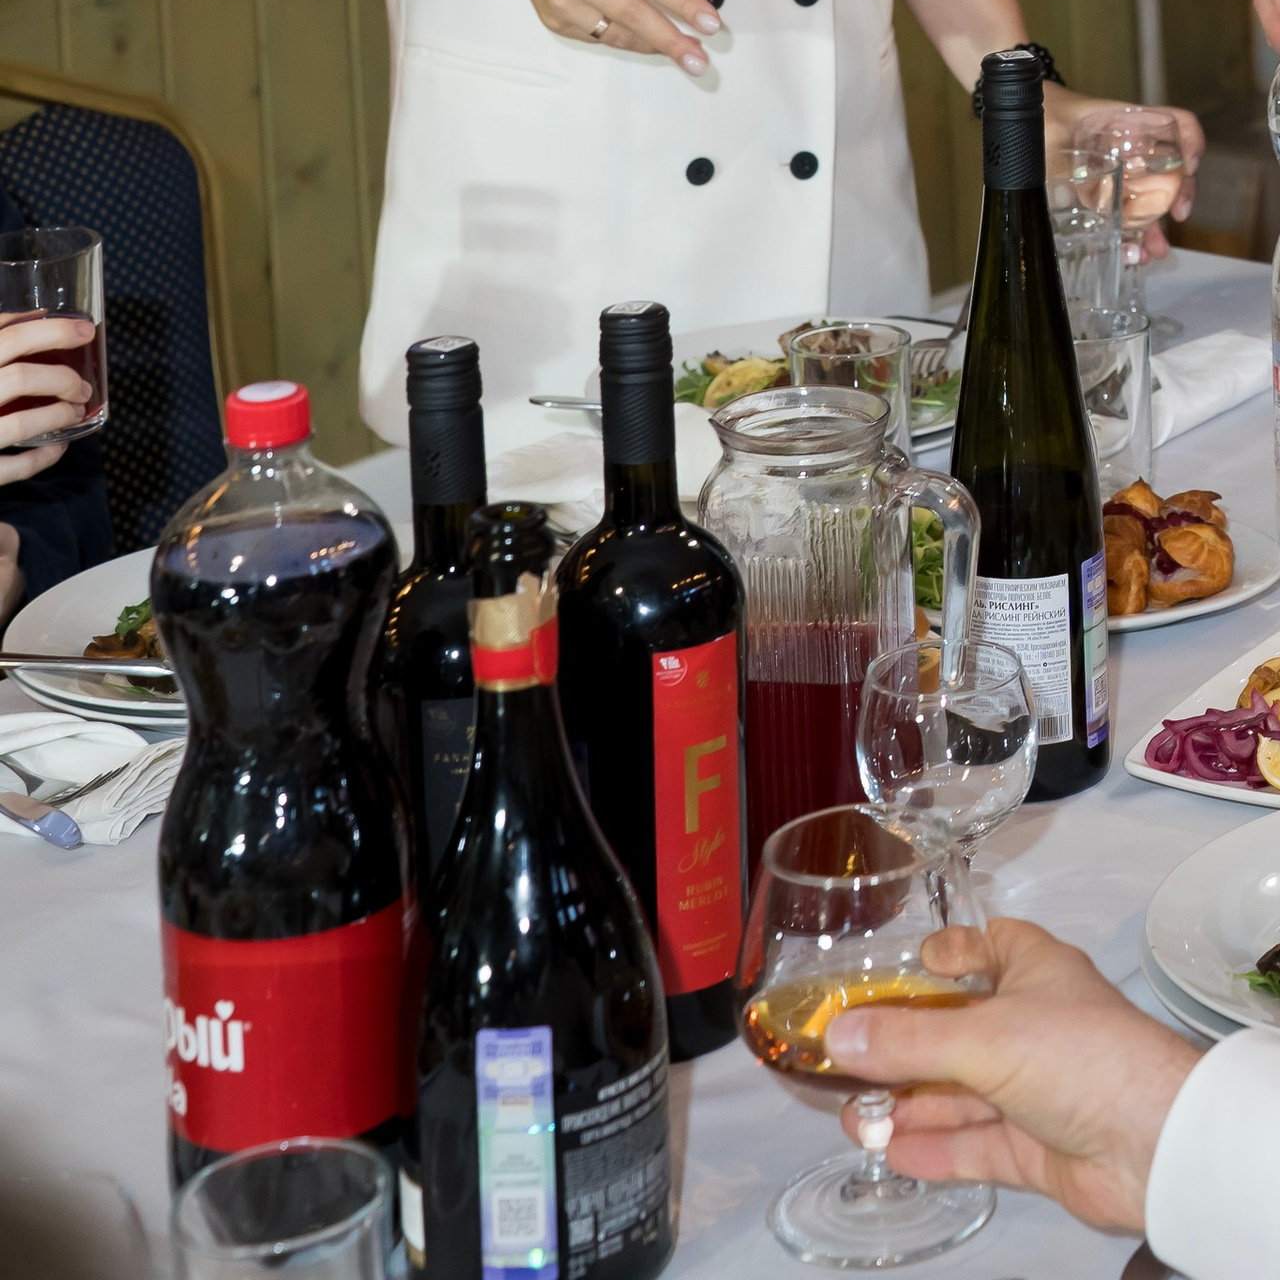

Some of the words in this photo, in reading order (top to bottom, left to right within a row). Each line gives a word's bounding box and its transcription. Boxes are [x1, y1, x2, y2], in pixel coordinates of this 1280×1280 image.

[984, 611, 1021, 621] РИСЛИНГ
[1023, 607, 1066, 621] РЕЙНСКИЙ
[989, 600, 1039, 611] РИСЛИНГ»
[684, 734, 727, 834] F
[679, 885, 729, 912] MERLOT
